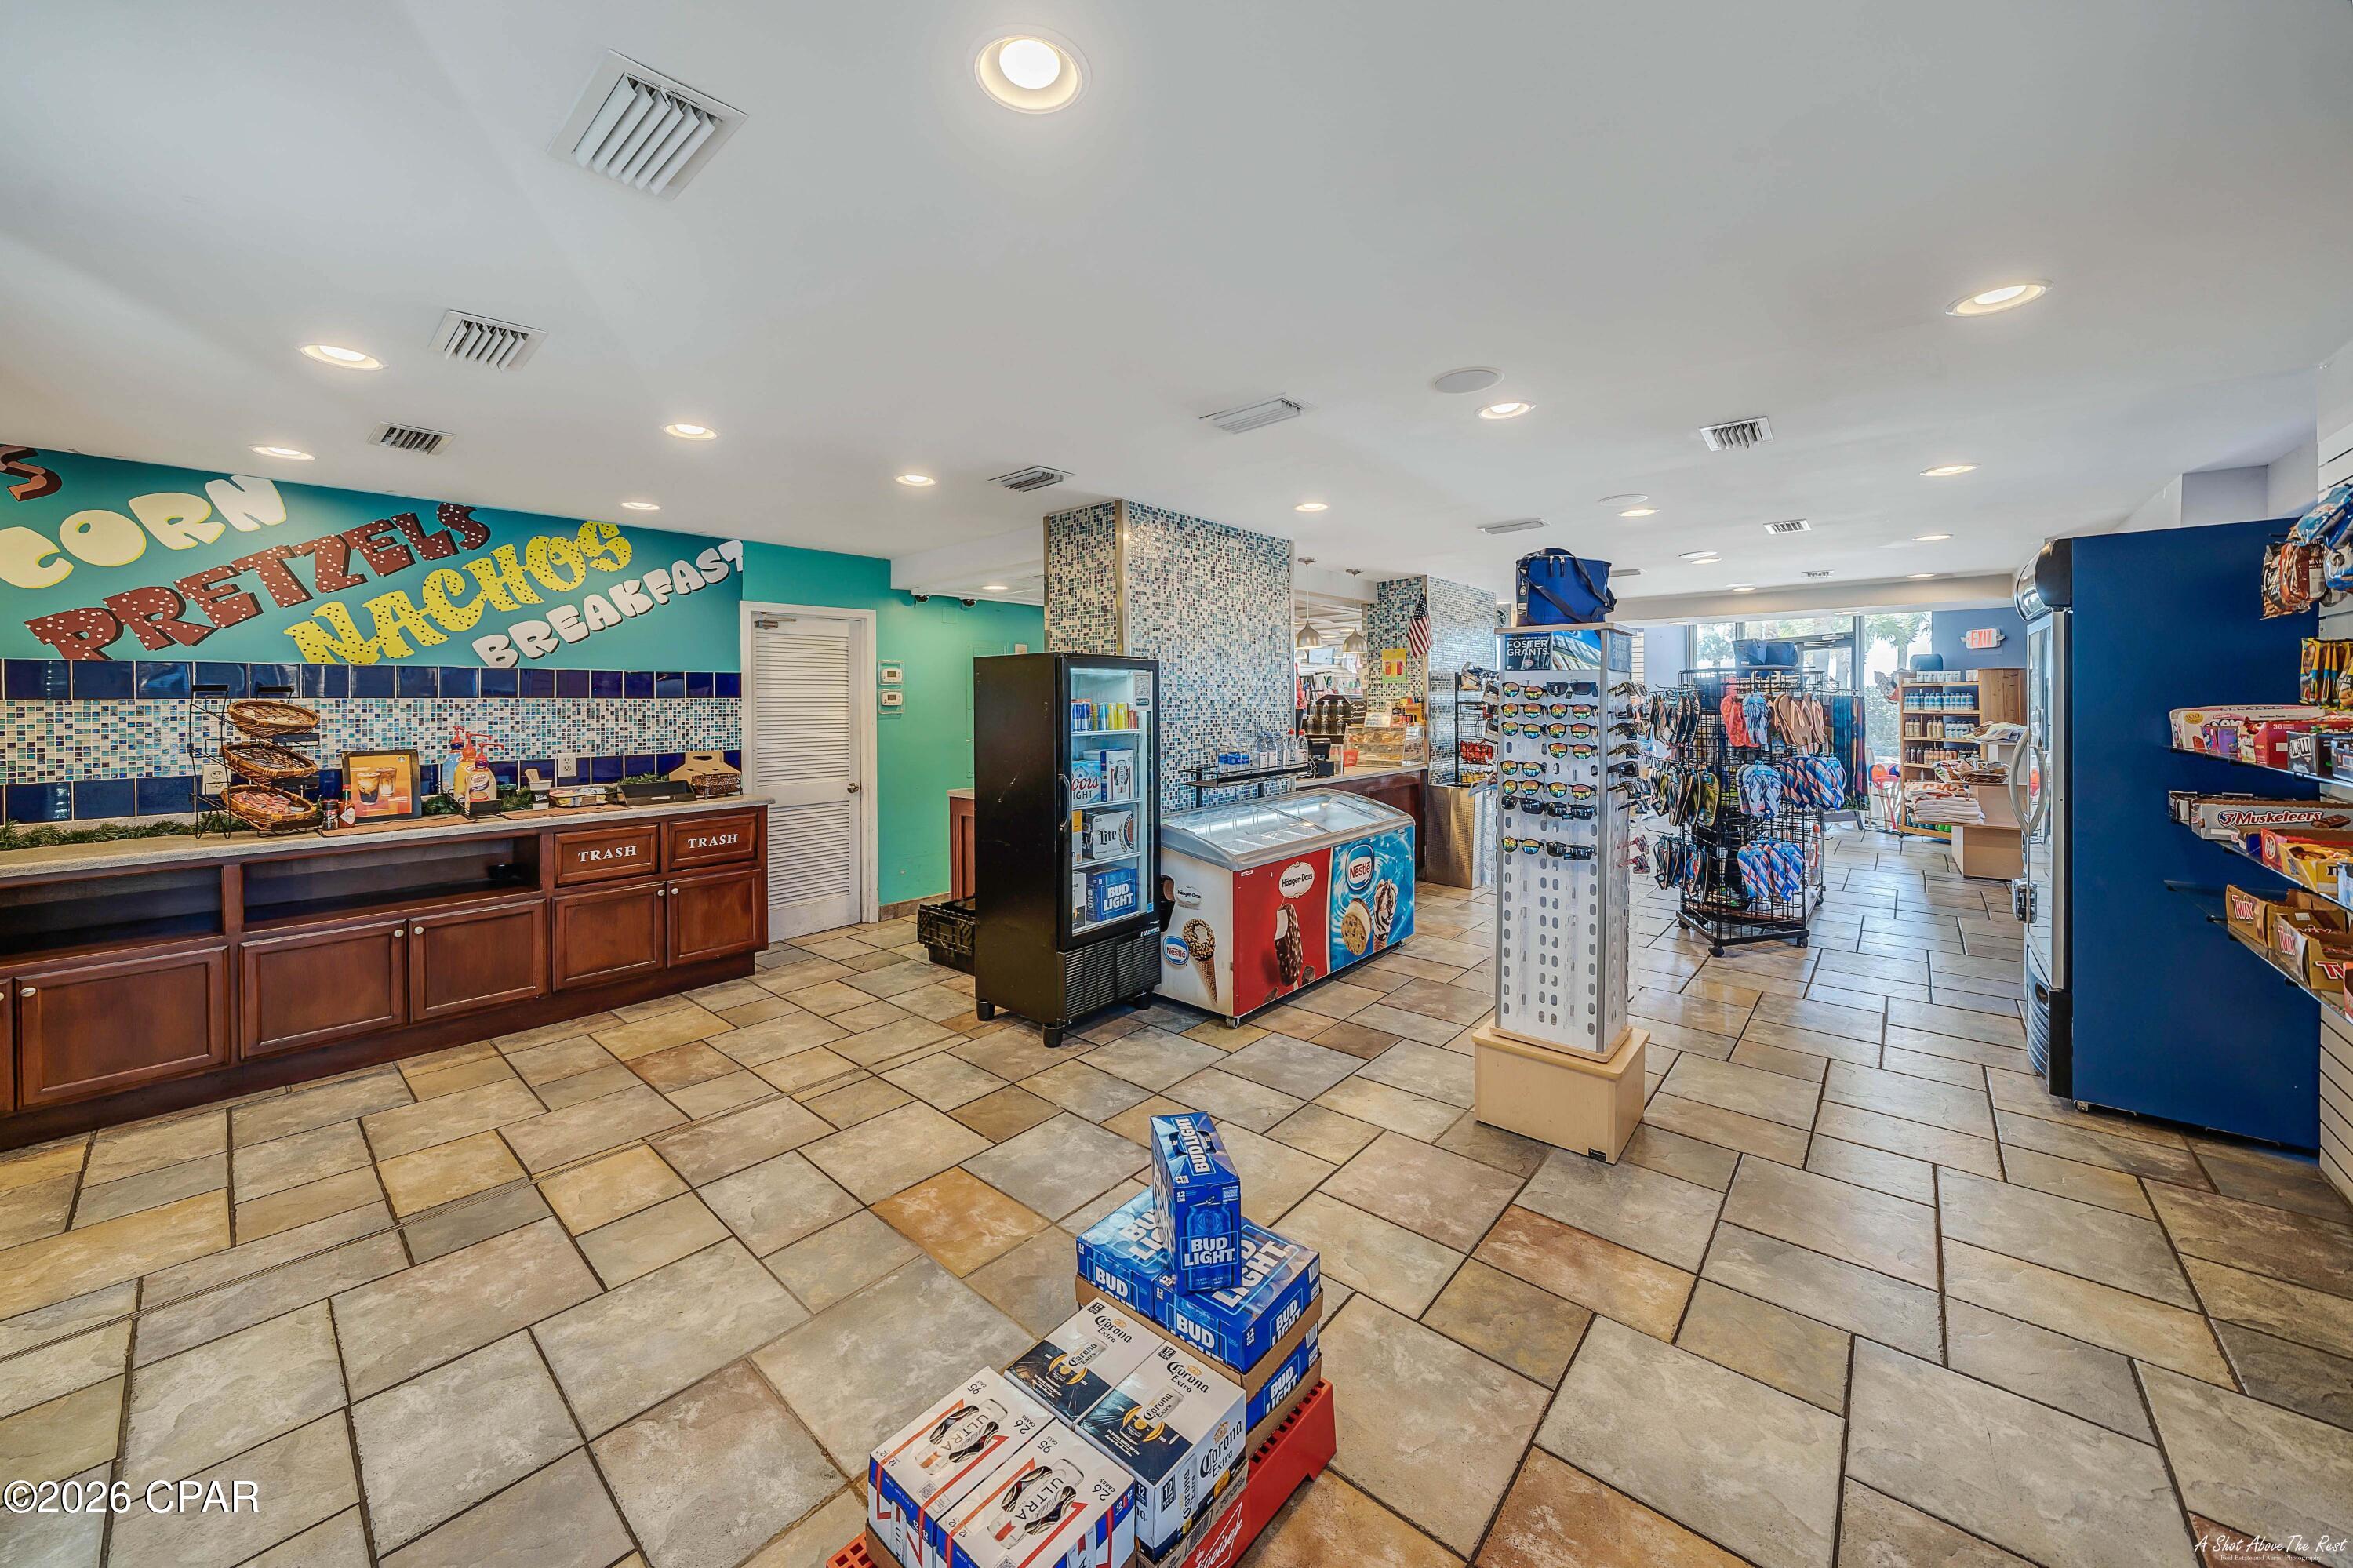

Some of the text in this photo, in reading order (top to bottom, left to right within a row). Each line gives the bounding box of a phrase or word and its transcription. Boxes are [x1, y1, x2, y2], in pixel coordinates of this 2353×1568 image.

[24, 502, 491, 660] PRETZELS
[284, 521, 633, 665] NACHOS
[471, 540, 744, 668] BREAKFAST
[1507, 640, 1547, 649] FOSTER
[1970, 628, 1994, 648] EXIT
[1072, 790, 1093, 799] IGHT
[2220, 811, 2322, 825] 3 Musketeers
[688, 833, 739, 849] TRASH
[1099, 831, 1117, 845] Lite
[578, 846, 638, 862] TRASH
[1282, 873, 1313, 887] Häagen-Dazs
[1107, 883, 1129, 899] BUD
[1104, 893, 1133, 911] LIGHT
[1175, 1118, 1210, 1173] BUD LIGHT
[1119, 1209, 1155, 1242] BU
[1191, 1237, 1228, 1253] BUD
[1095, 1265, 1128, 1297] BUD
[1276, 1299, 1297, 1332] BUD
[1095, 1315, 1132, 1343] Corona
[1097, 1326, 1116, 1343] Extra
[1176, 1313, 1215, 1348] BUD
[1247, 1327, 1254, 1338] 12
[1068, 1343, 1097, 1366] Corona
[1162, 1348, 1174, 1356] 12
[1166, 1362, 1209, 1393] Corona
[1171, 1374, 1192, 1393] Extra
[1270, 1366, 1294, 1399] BUD
[967, 1384, 982, 1395] 95
[1143, 1393, 1173, 1420] Corona
[1157, 1403, 1173, 1418] Extra
[1013, 1420, 1031, 1434] 2.6
[1021, 1414, 1035, 1428] CARBS
[941, 1414, 989, 1450] ULTRA
[1037, 1440, 1051, 1453] 95
[1200, 1421, 1242, 1479] Corona
[1212, 1450, 1233, 1479] Extra
[1092, 1484, 1111, 1501] 2.6
[1099, 1478, 1115, 1493] CARBS
[1137, 1483, 1146, 1495] 12
[1164, 1479, 1174, 1500] 12
[1183, 1468, 1191, 1519] Corona
[1015, 1478, 1064, 1520] ULTRA
[1116, 1501, 1123, 1511] 12
[913, 1519, 918, 1529] 12
[948, 1519, 957, 1528] 12
[922, 1530, 929, 1540] 12
[958, 1530, 967, 1538] 12
